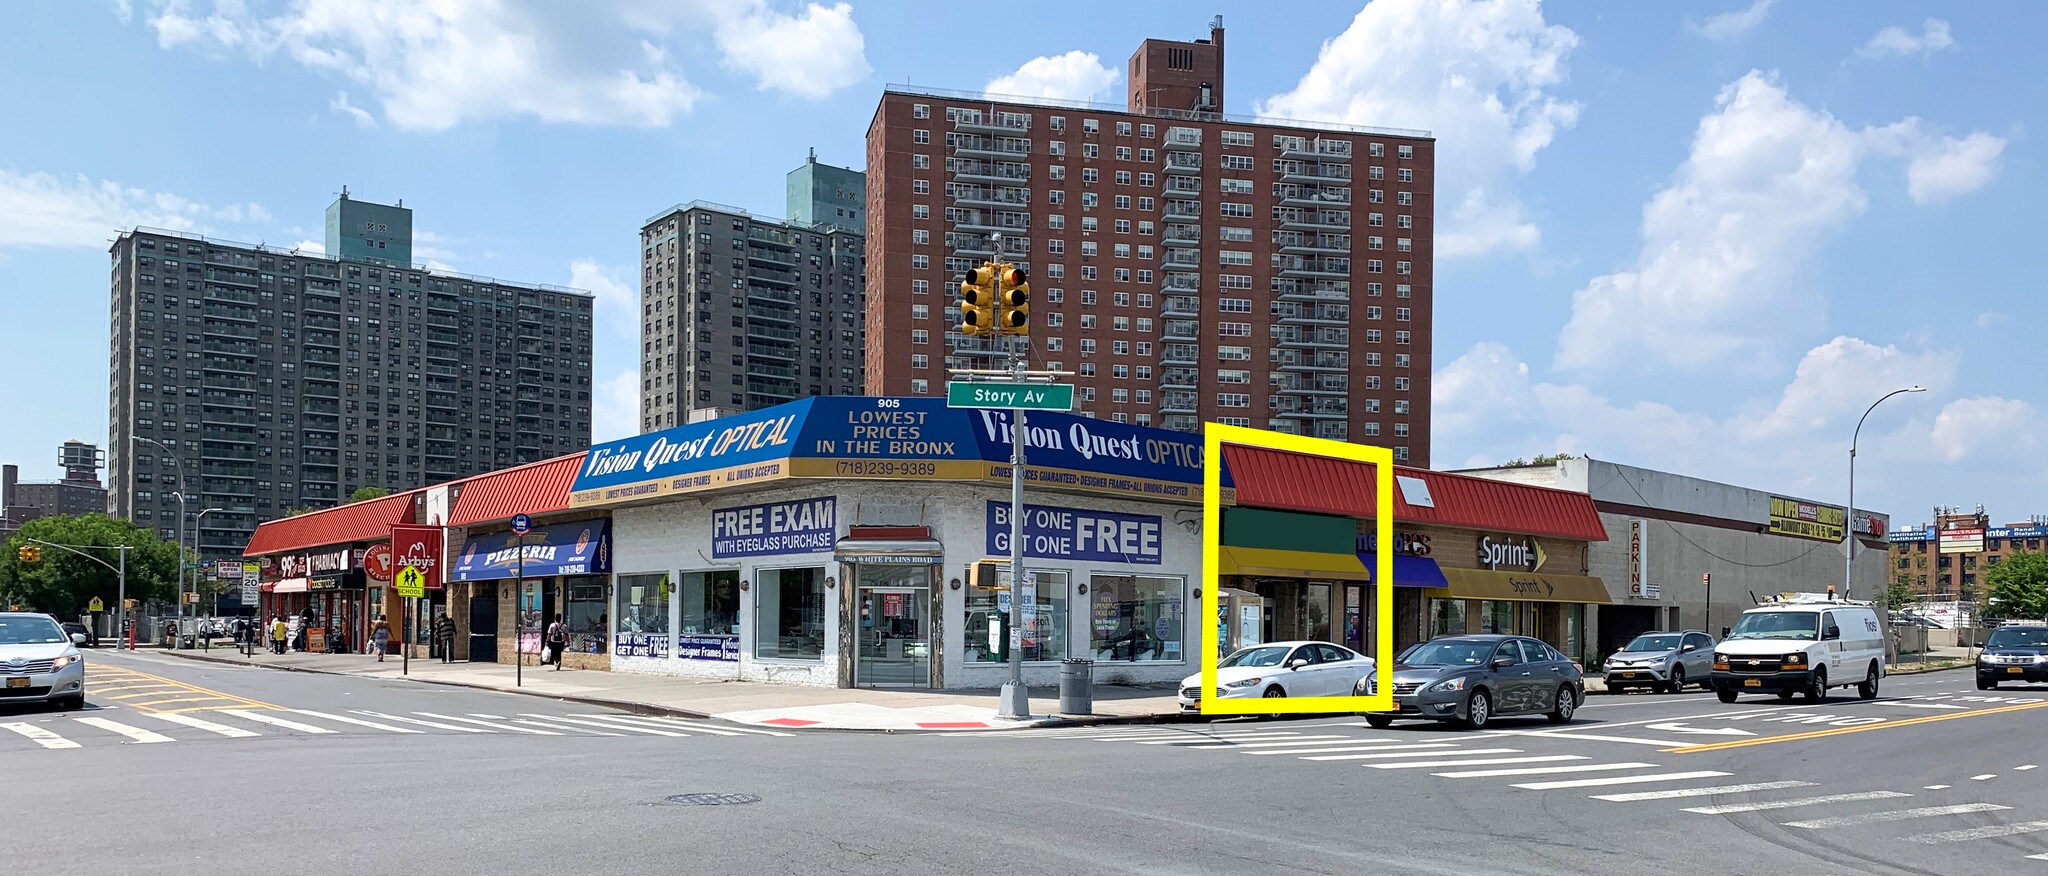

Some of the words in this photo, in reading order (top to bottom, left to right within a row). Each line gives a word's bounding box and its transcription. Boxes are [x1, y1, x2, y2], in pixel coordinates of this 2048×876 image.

[877, 398, 900, 408] 905
[974, 388, 1016, 406] Story
[1024, 390, 1045, 403] Av
[848, 410, 928, 424] LOWEST
[853, 425, 920, 440] PRICES
[1070, 422, 1143, 461] Quest
[585, 445, 642, 478] Vision
[644, 428, 715, 473] Quest
[710, 414, 796, 457] OPTICAL
[816, 440, 835, 453] IN
[844, 440, 881, 454] THE
[889, 441, 955, 456] BRONX
[726, 471, 736, 482] ALL
[736, 468, 754, 480] UNIONS
[754, 463, 780, 478] ACCEPTED
[836, 460, 936, 476] (718)239-9389
[672, 477, 693, 491] DESIGNER
[693, 475, 711, 487] FRAMES
[1039, 470, 1077, 485] GUARANTEED
[1080, 474, 1108, 487] DESIGNER
[1109, 477, 1131, 491] FRAMES
[605, 489, 620, 500] LOWEST
[620, 487, 633, 499] PRICES
[633, 483, 658, 497] GUARANTEED
[1132, 479, 1143, 491] ALL
[1143, 481, 1162, 494] UNIONS
[1162, 483, 1188, 497] ACCEPTED
[1770, 498, 1784, 516] NOW
[1784, 500, 1799, 518] OPEN
[714, 507, 764, 538] FREE
[770, 499, 833, 533] EXAM
[1035, 510, 1072, 531] ONE
[715, 539, 735, 554] WITH
[736, 535, 780, 552] EYEGLASS
[781, 532, 831, 550] PURCHASE
[1034, 535, 1071, 555] ONE
[1076, 517, 1159, 556] FREE
[1356, 531, 1432, 556] meoPCS
[311, 552, 341, 571] PHARMACY
[483, 546, 557, 566] PIZZERIA
[1482, 535, 1529, 571] Sprint
[1631, 522, 1640, 593] PARKING
[398, 555, 436, 570] Arby's
[244, 579, 258, 587] 20
[1509, 577, 1542, 596] Sprint
[1864, 617, 1877, 633] fios
[618, 635, 633, 645] BUY
[634, 635, 648, 646] ONE
[649, 636, 668, 655] FREE
[722, 639, 726, 660] 1
[616, 645, 632, 655] GET
[633, 645, 649, 656] ONE
[701, 646, 722, 657] Frames
